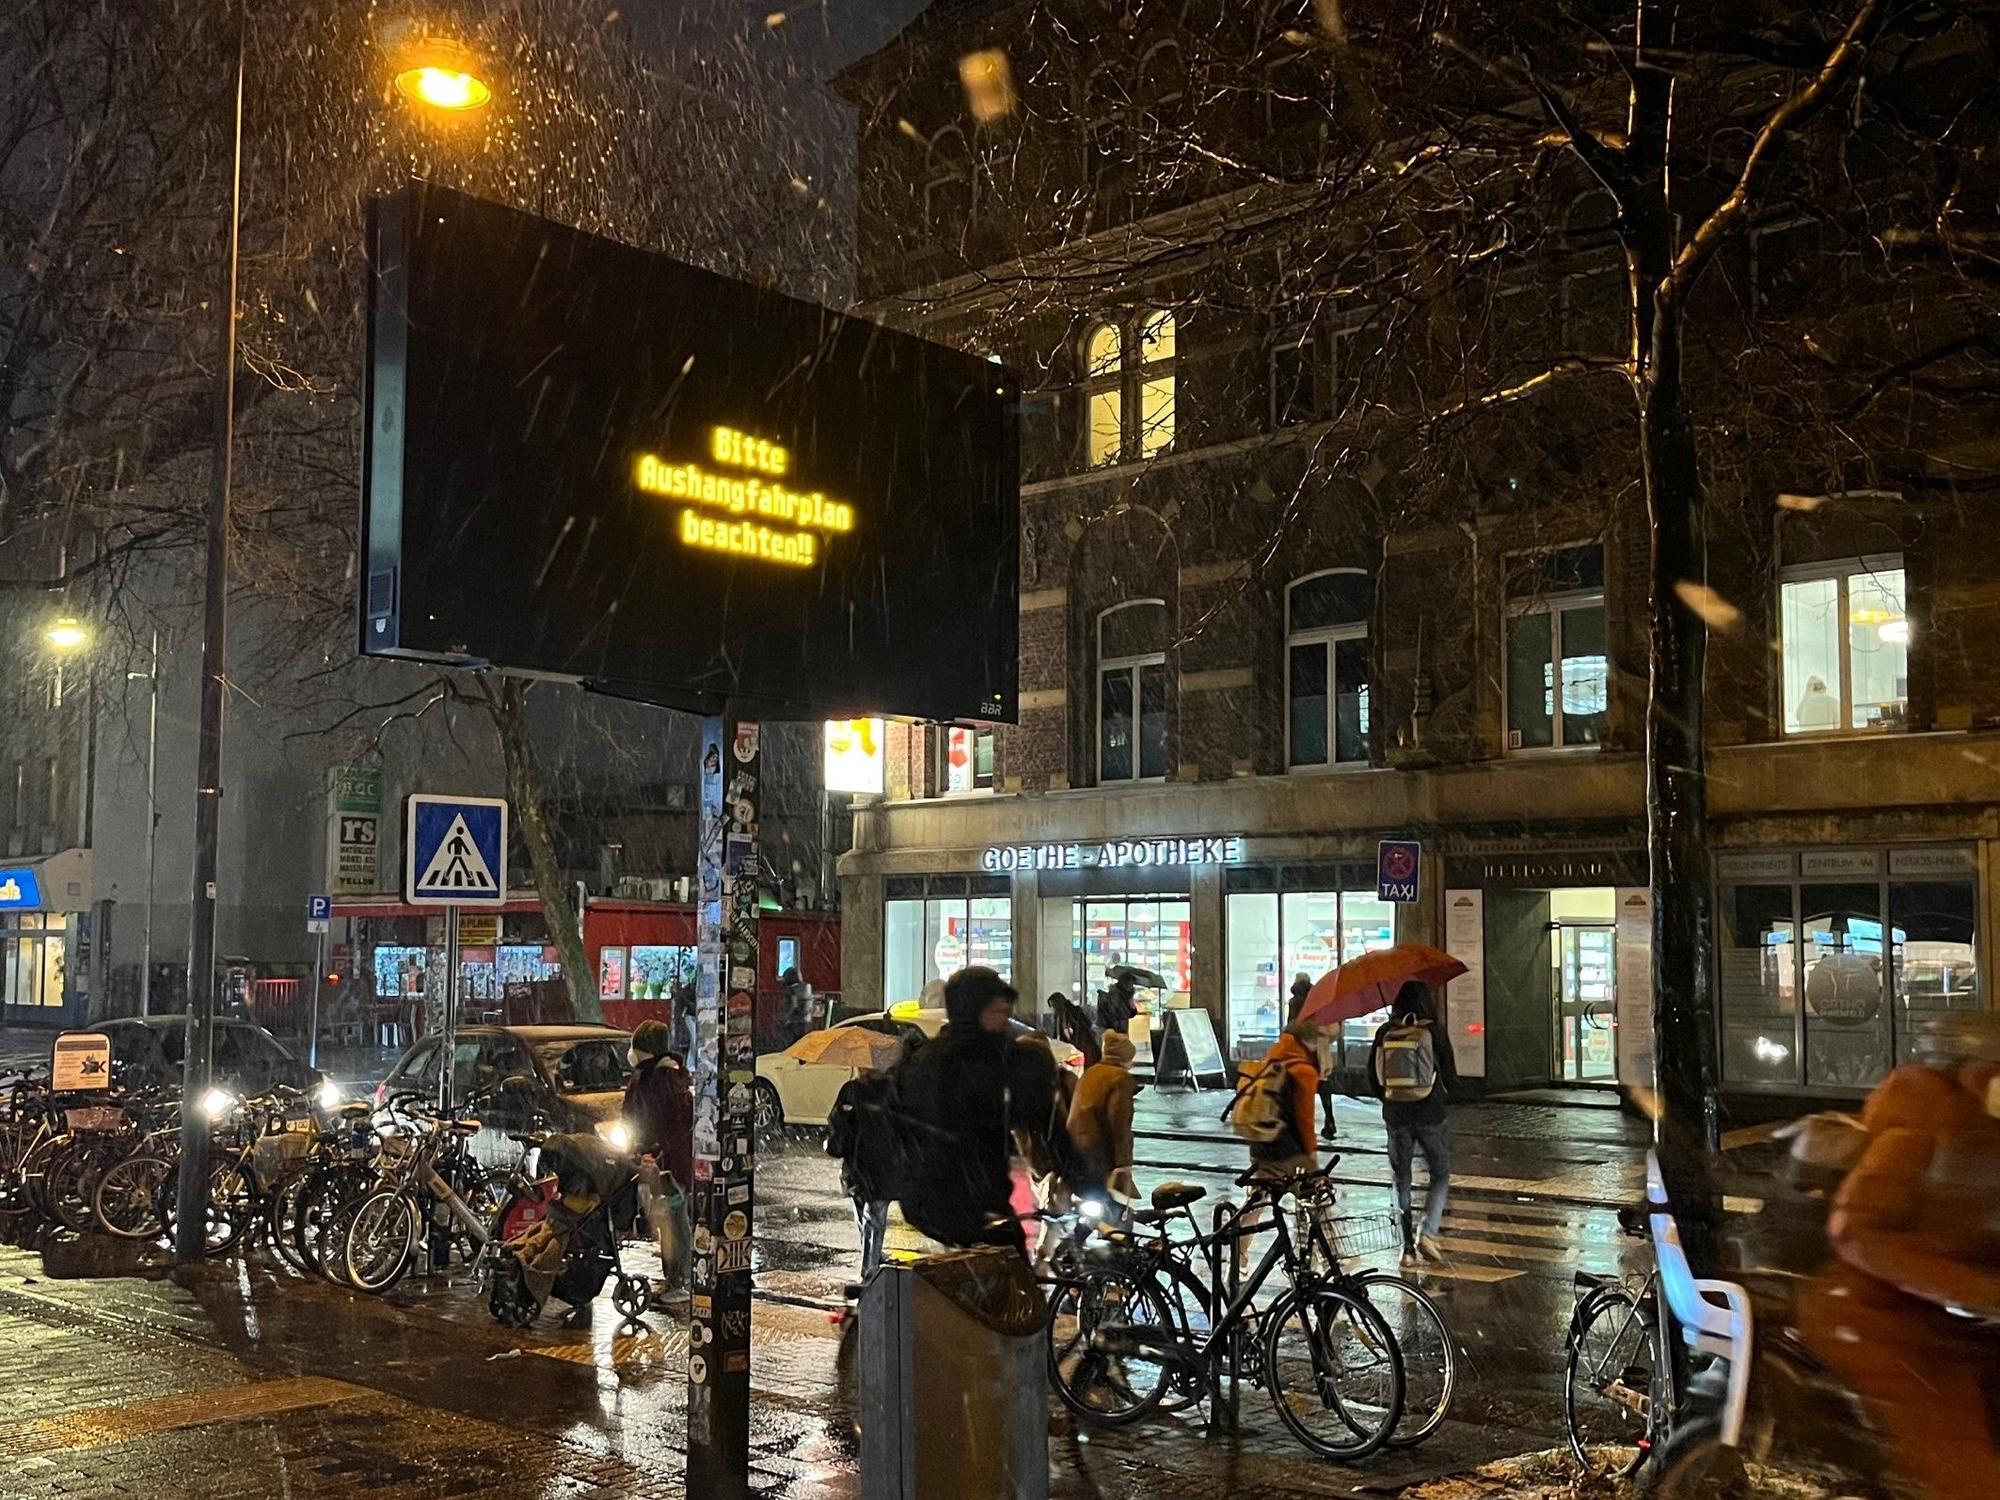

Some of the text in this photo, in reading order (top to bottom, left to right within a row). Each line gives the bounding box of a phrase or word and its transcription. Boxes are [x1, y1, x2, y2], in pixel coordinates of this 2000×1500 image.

[712, 426, 788, 474] Bitte
[638, 454, 855, 531] Aushangfahrplan
[681, 508, 815, 566] beachten!!
[1484, 863, 1604, 877] HELIOSHAU
[339, 877, 375, 886] YELLOW
[1381, 883, 1414, 898] TAXI
[313, 898, 326, 917] P
